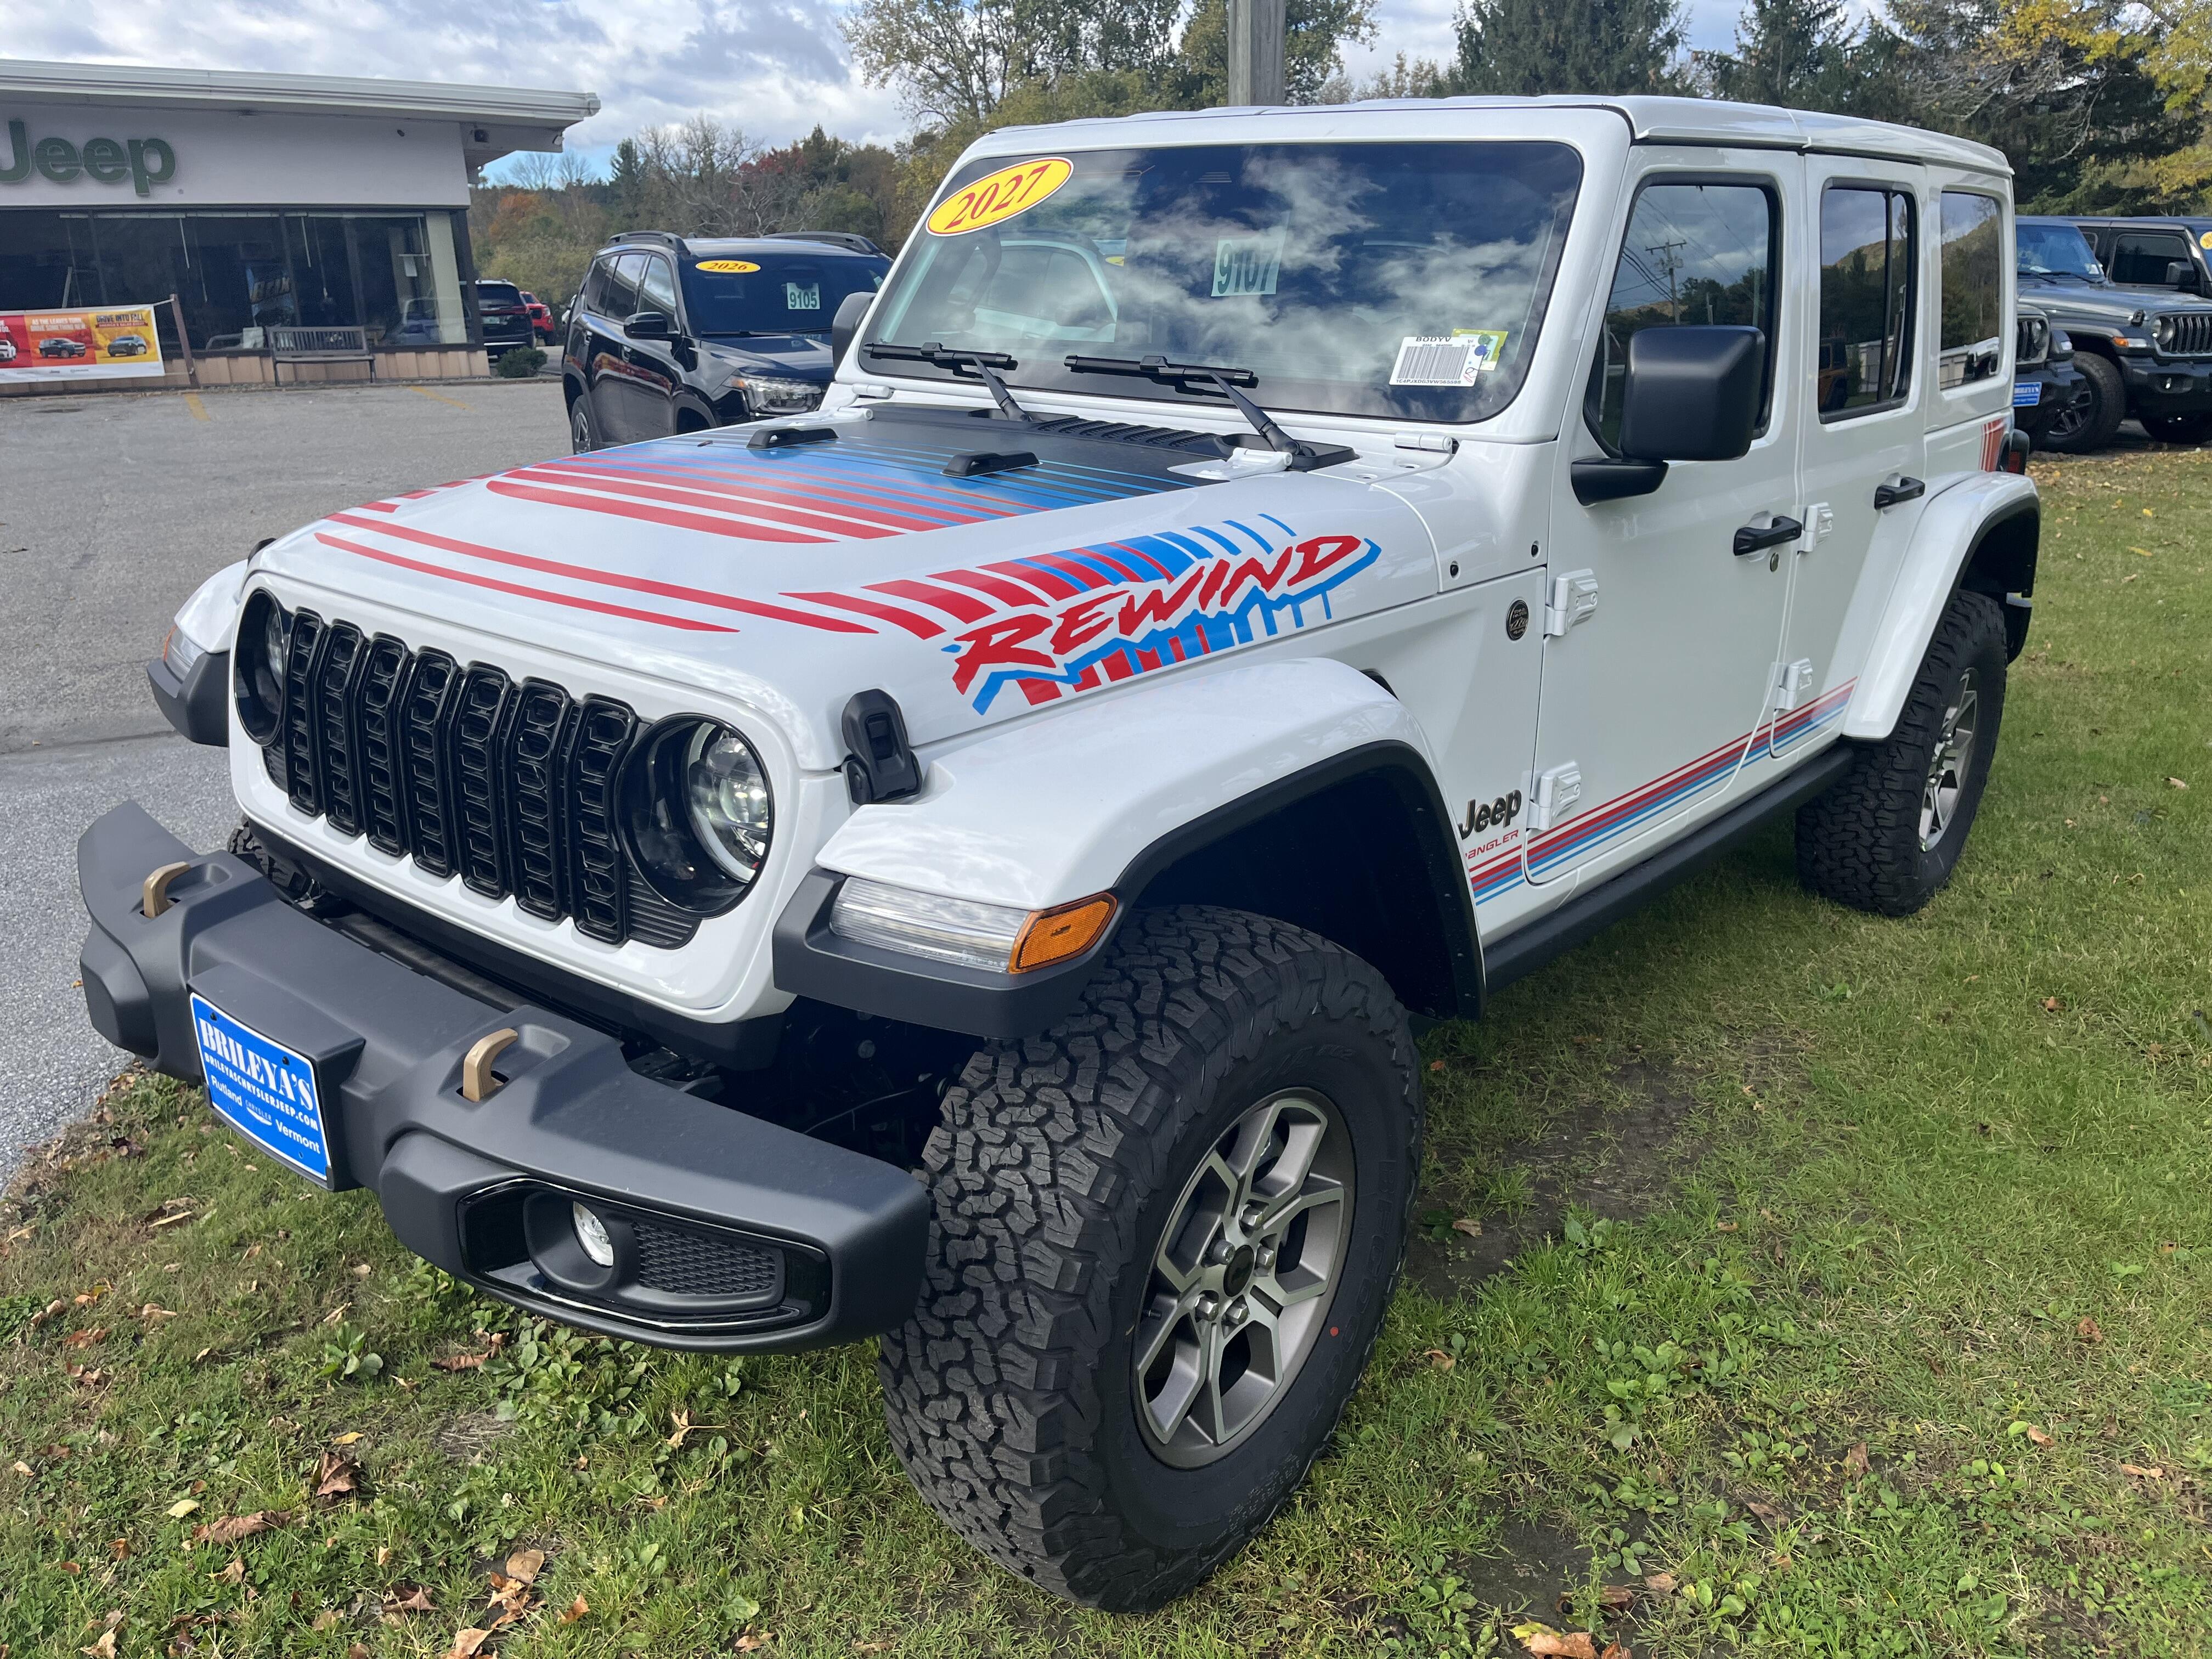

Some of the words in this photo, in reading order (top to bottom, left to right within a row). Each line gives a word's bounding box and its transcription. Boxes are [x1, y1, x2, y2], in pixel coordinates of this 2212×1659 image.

[0, 119, 176, 194] Jeep
[944, 163, 1052, 230] 2027
[708, 262, 747, 270] 2026
[1217, 243, 1276, 294] 9107
[789, 291, 817, 308] 9105
[953, 535, 1361, 695] REWIND
[1457, 789, 1522, 840] Jeep
[1465, 830, 1519, 860] ANGLER
[198, 1018, 313, 1111] BRILEYA'S
[205, 1052, 319, 1131] BRILEYASCHRYSLERJEEP.COM
[211, 1075, 242, 1107] Rutland
[245, 1099, 272, 1122] CHRYSLER
[275, 1120, 320, 1154] Vermont
